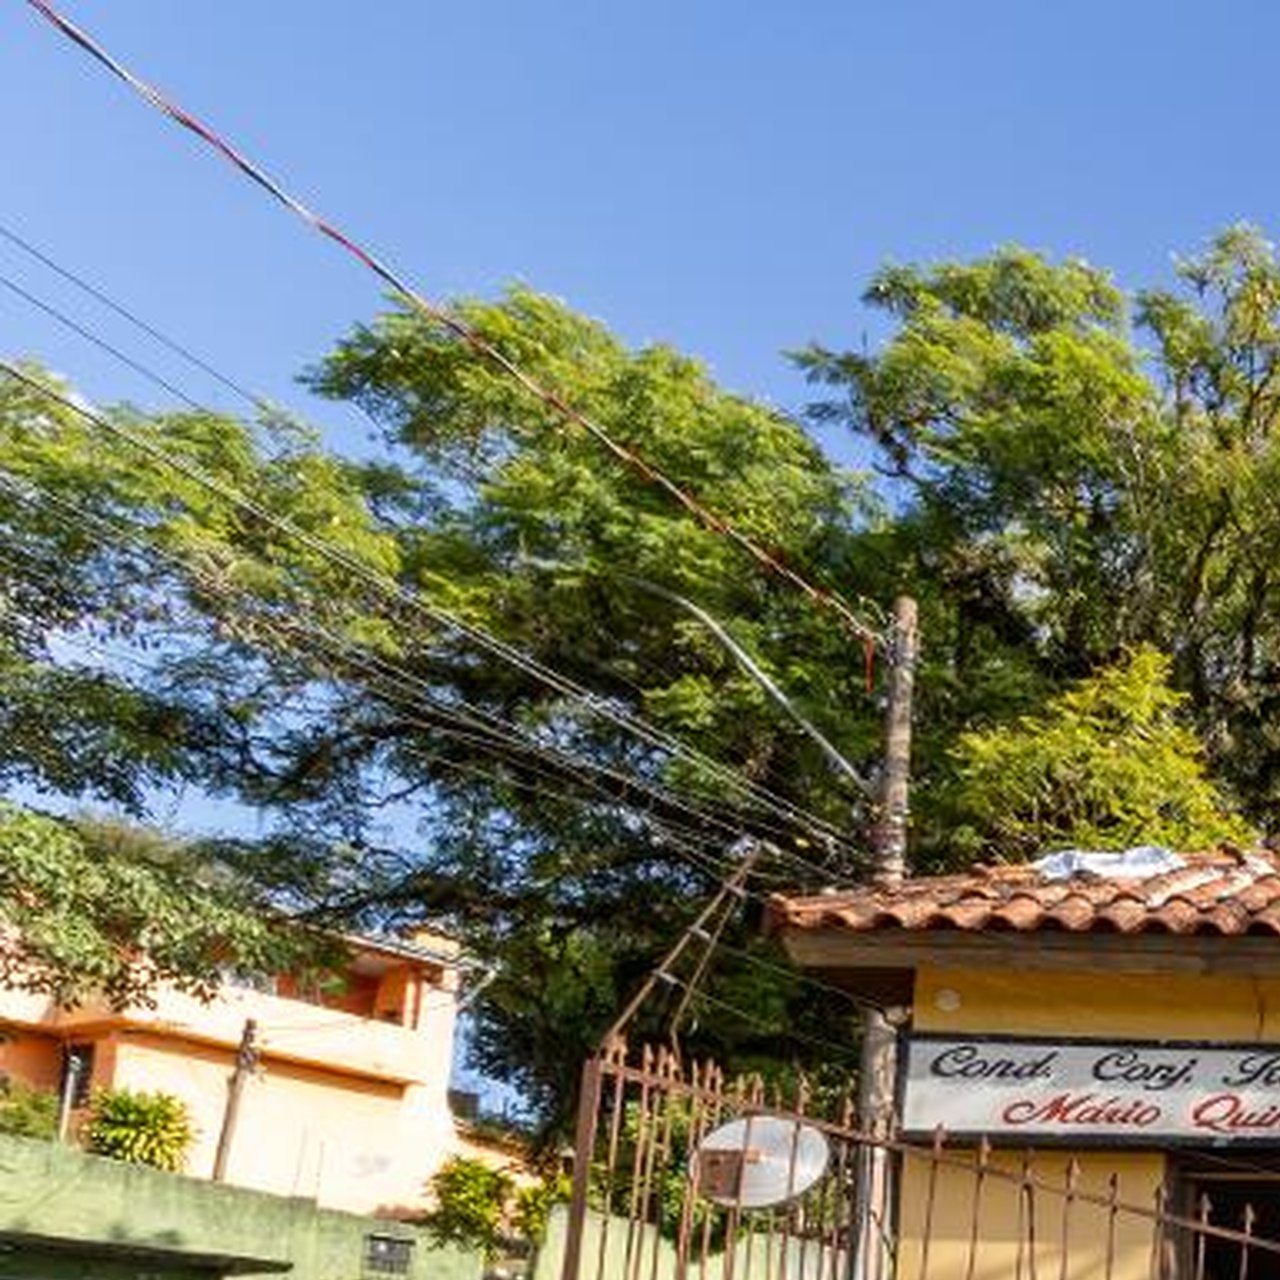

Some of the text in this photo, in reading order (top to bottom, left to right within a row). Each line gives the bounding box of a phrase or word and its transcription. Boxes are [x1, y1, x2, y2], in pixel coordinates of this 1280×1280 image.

[930, 1046, 1058, 1079] Cond.
[1092, 1050, 1192, 1091] Conj.
[1003, 1093, 1162, 1127] Mário
